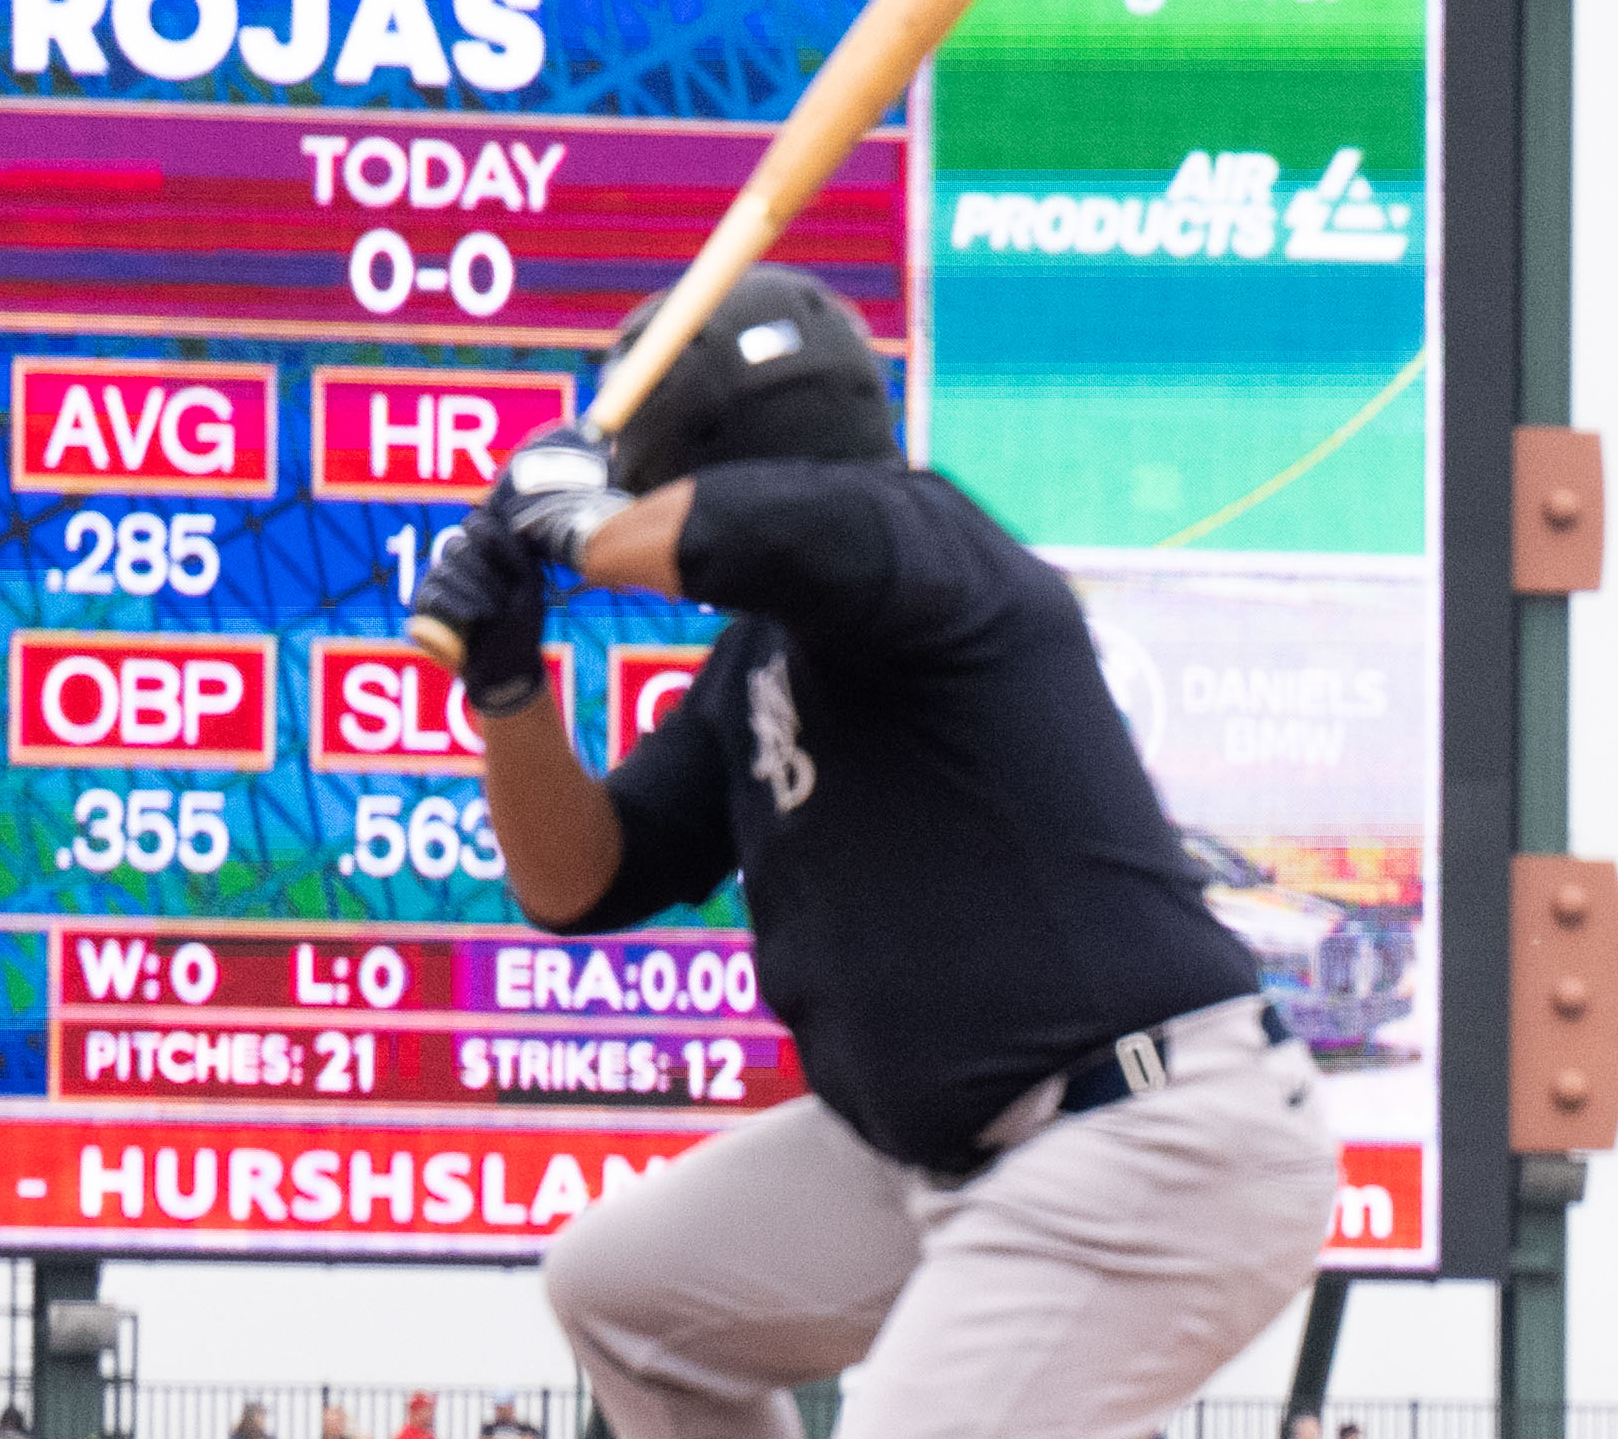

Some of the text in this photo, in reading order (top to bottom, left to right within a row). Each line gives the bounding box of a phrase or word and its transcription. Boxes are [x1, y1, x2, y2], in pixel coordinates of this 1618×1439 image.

[301, 135, 566, 212] TODAY
[1165, 149, 1283, 202] AIR
[950, 192, 1278, 260] PRODUCTS
[348, 227, 516, 318] 0-0
[43, 384, 237, 476] AVG
[369, 392, 500, 480] HR
[44, 510, 221, 597] .285
[386, 523, 464, 606] 1
[41, 657, 244, 745] OBP
[1182, 665, 1388, 718] DANIELS
[1225, 716, 1344, 765] BMW
[55, 789, 230, 875] .355
[338, 795, 506, 879] .563
[84, 1029, 746, 1101] PITCHES: 21 STRIKES: 12
